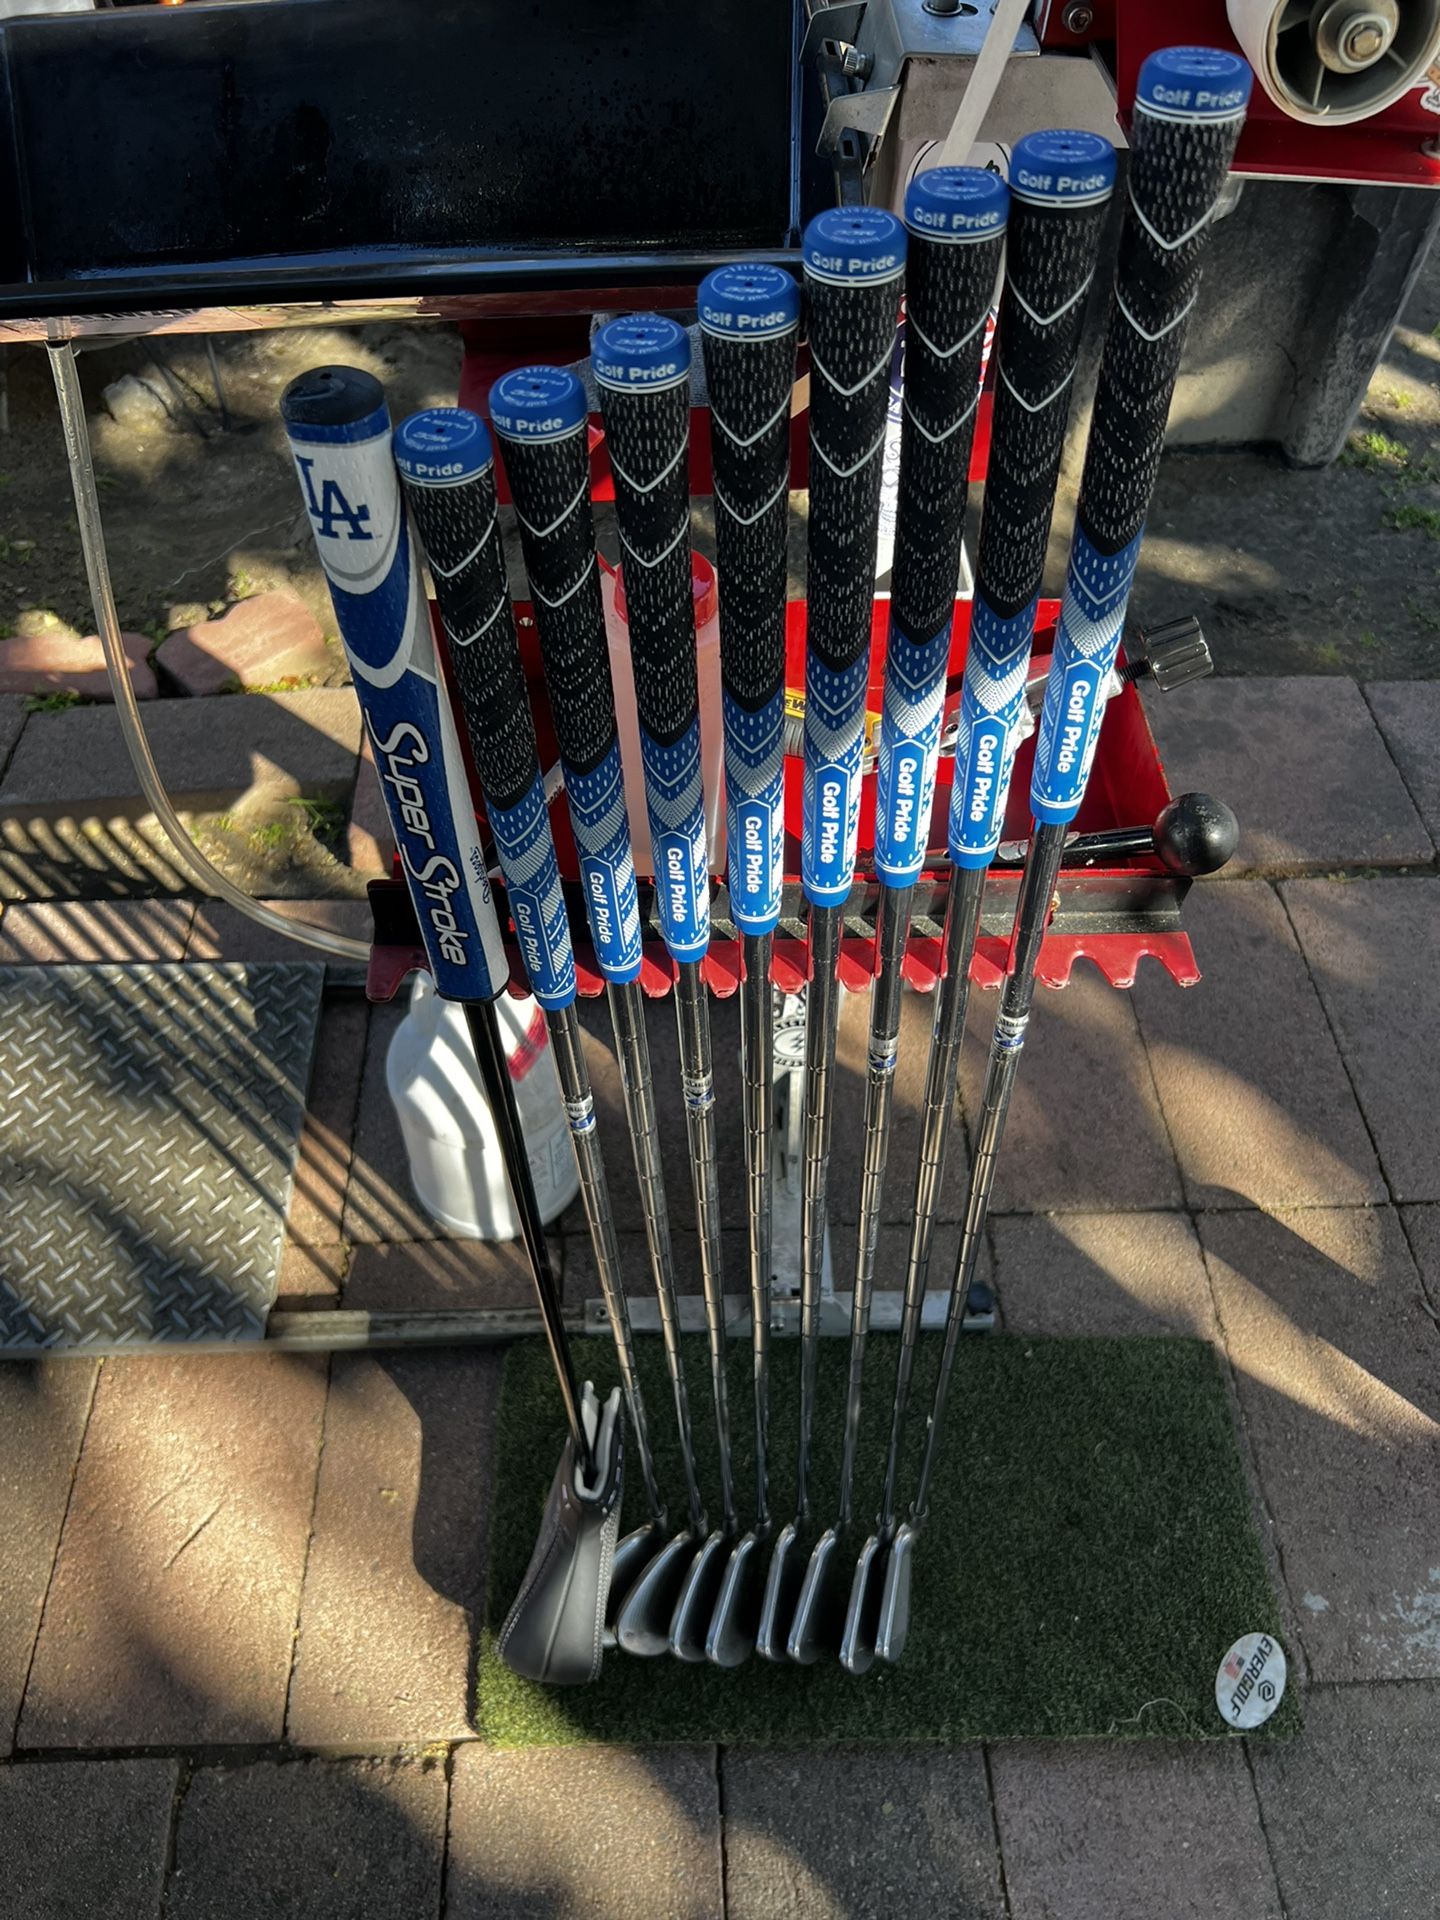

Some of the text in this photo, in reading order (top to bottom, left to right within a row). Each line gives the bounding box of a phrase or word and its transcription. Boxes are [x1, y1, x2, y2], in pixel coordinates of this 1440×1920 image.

[1152, 84, 1243, 107] Golf Pride
[1018, 170, 1052, 191] Golf
[1057, 174, 1106, 192] Pride
[914, 208, 945, 227] Golf
[952, 212, 1000, 229] Pride
[811, 252, 896, 273] Golf Pride
[703, 306, 786, 328] Golf Pride
[595, 359, 676, 381] Golf Pride
[516, 418, 564, 432] Pride
[295, 454, 374, 540] LA
[416, 463, 464, 477] Pride
[1057, 680, 1091, 774] Golf Pride
[893, 758, 917, 843] Golf Pride
[970, 735, 998, 822] Golf Pride
[745, 816, 763, 895] Golf Pride
[820, 782, 841, 864] Golf Pride
[588, 872, 611, 944] Golf Pride
[667, 848, 686, 923] Golf Pride
[516, 903, 541, 972] Golf Pride
[1230, 1636, 1273, 1717] EVERGOLF
